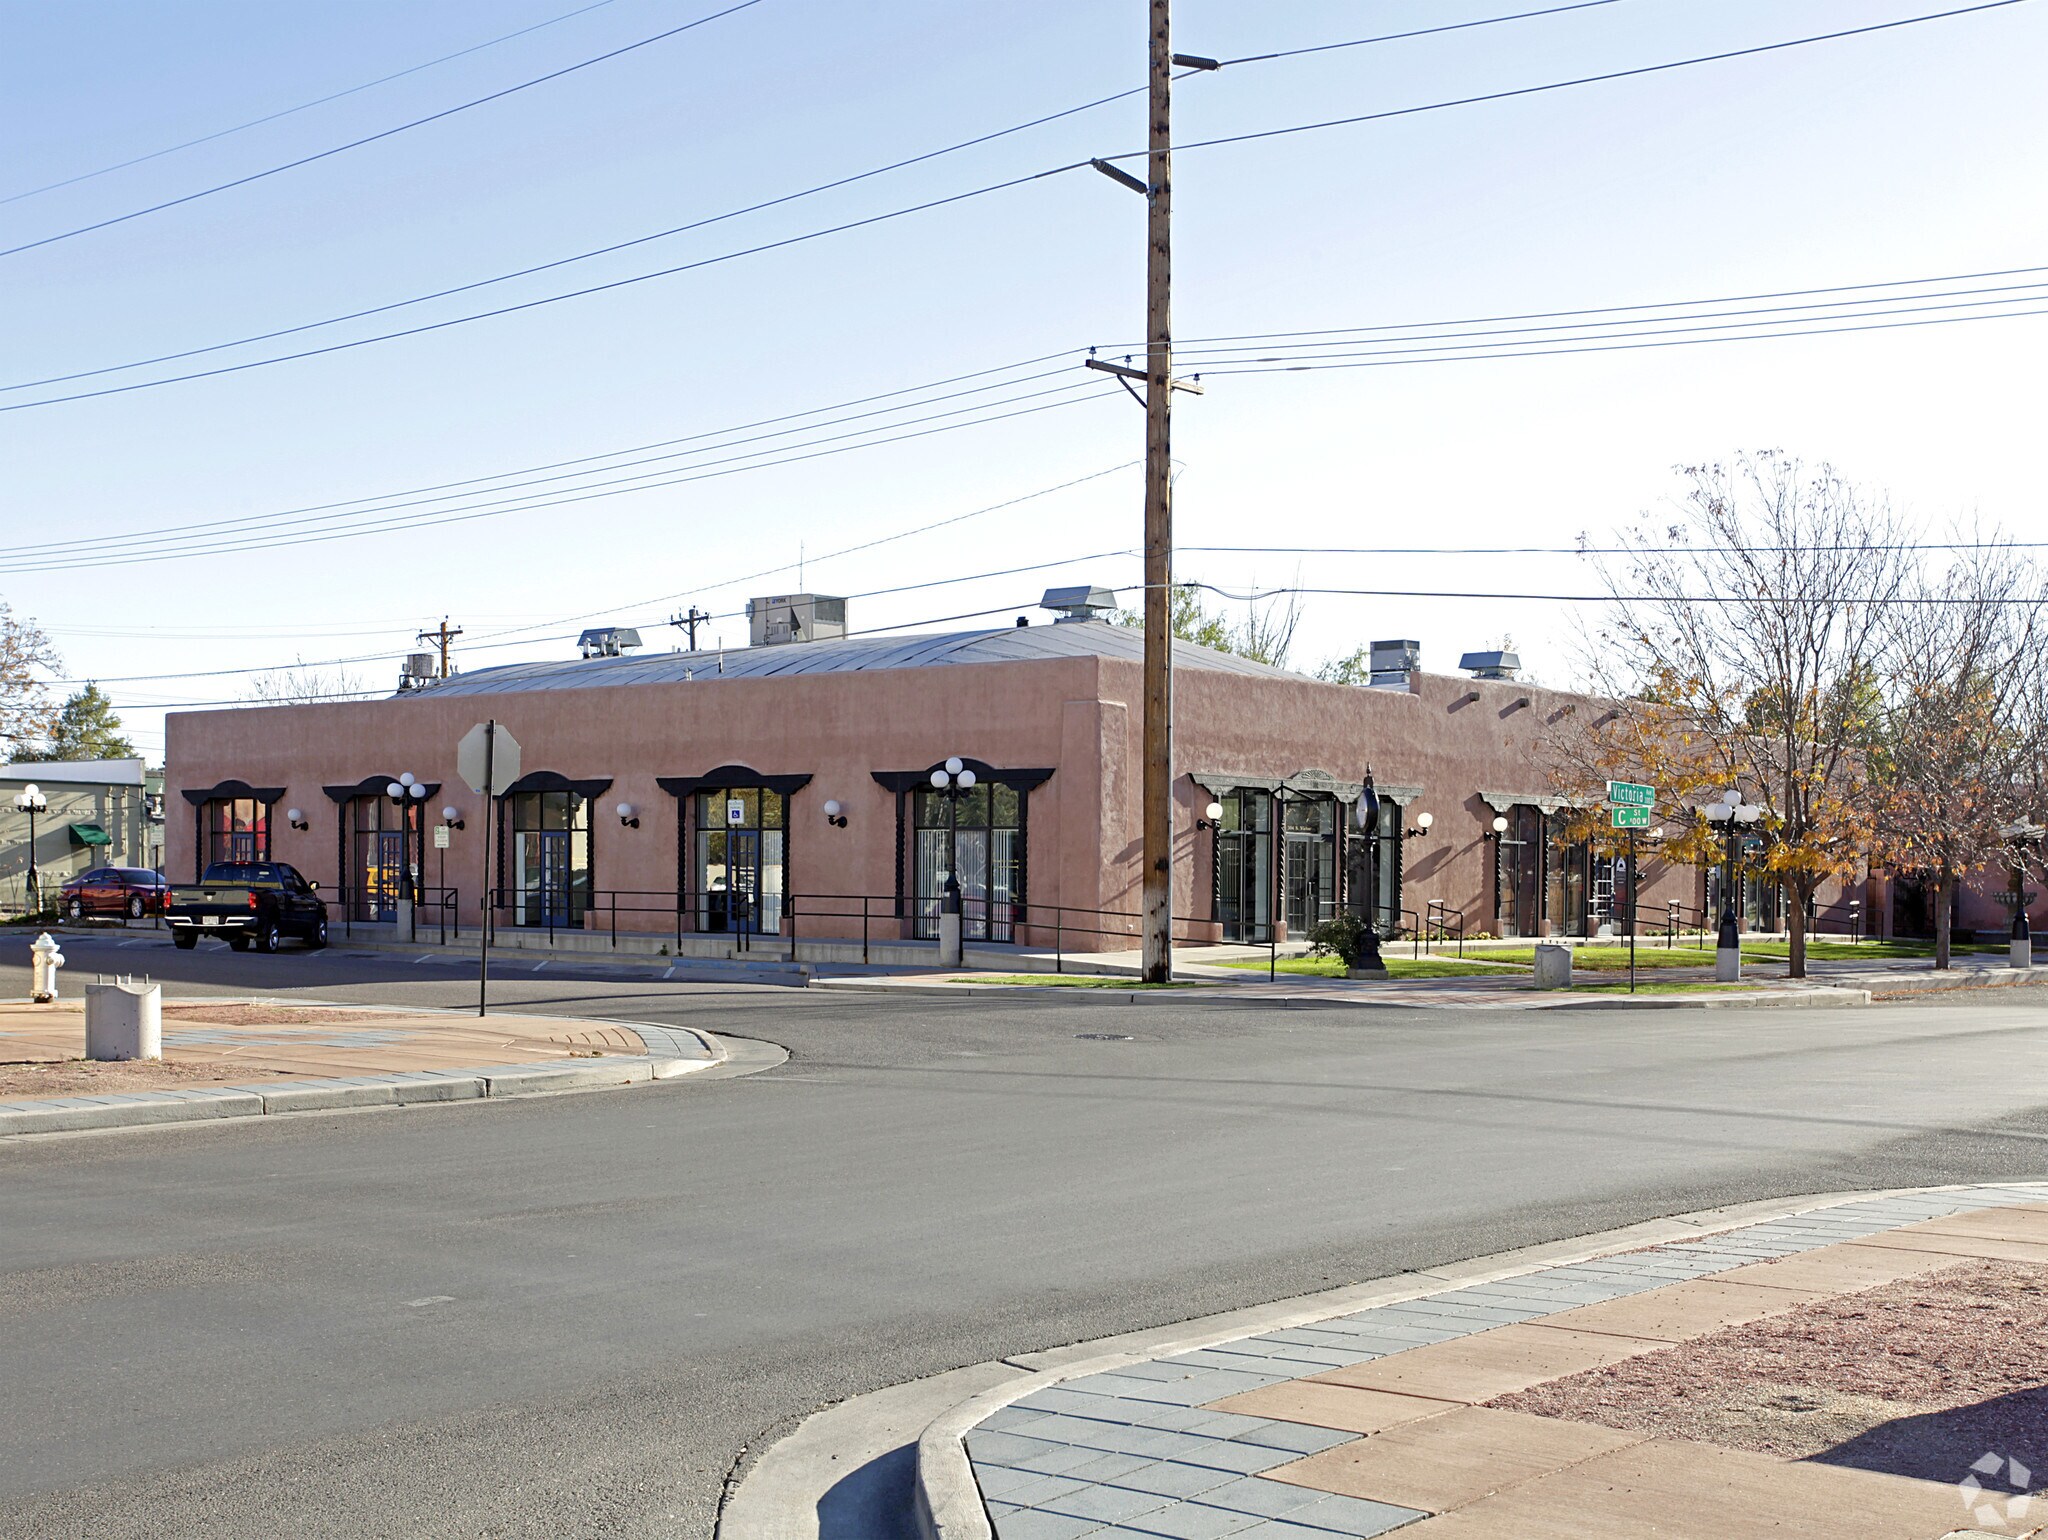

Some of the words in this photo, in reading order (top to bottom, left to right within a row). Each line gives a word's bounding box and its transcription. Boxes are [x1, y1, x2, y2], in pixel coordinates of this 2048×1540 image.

[1613, 784, 1643, 802] Victoria
[1618, 809, 1626, 825] C
[1633, 808, 1641, 816] St
[1641, 817, 1647, 825] W
